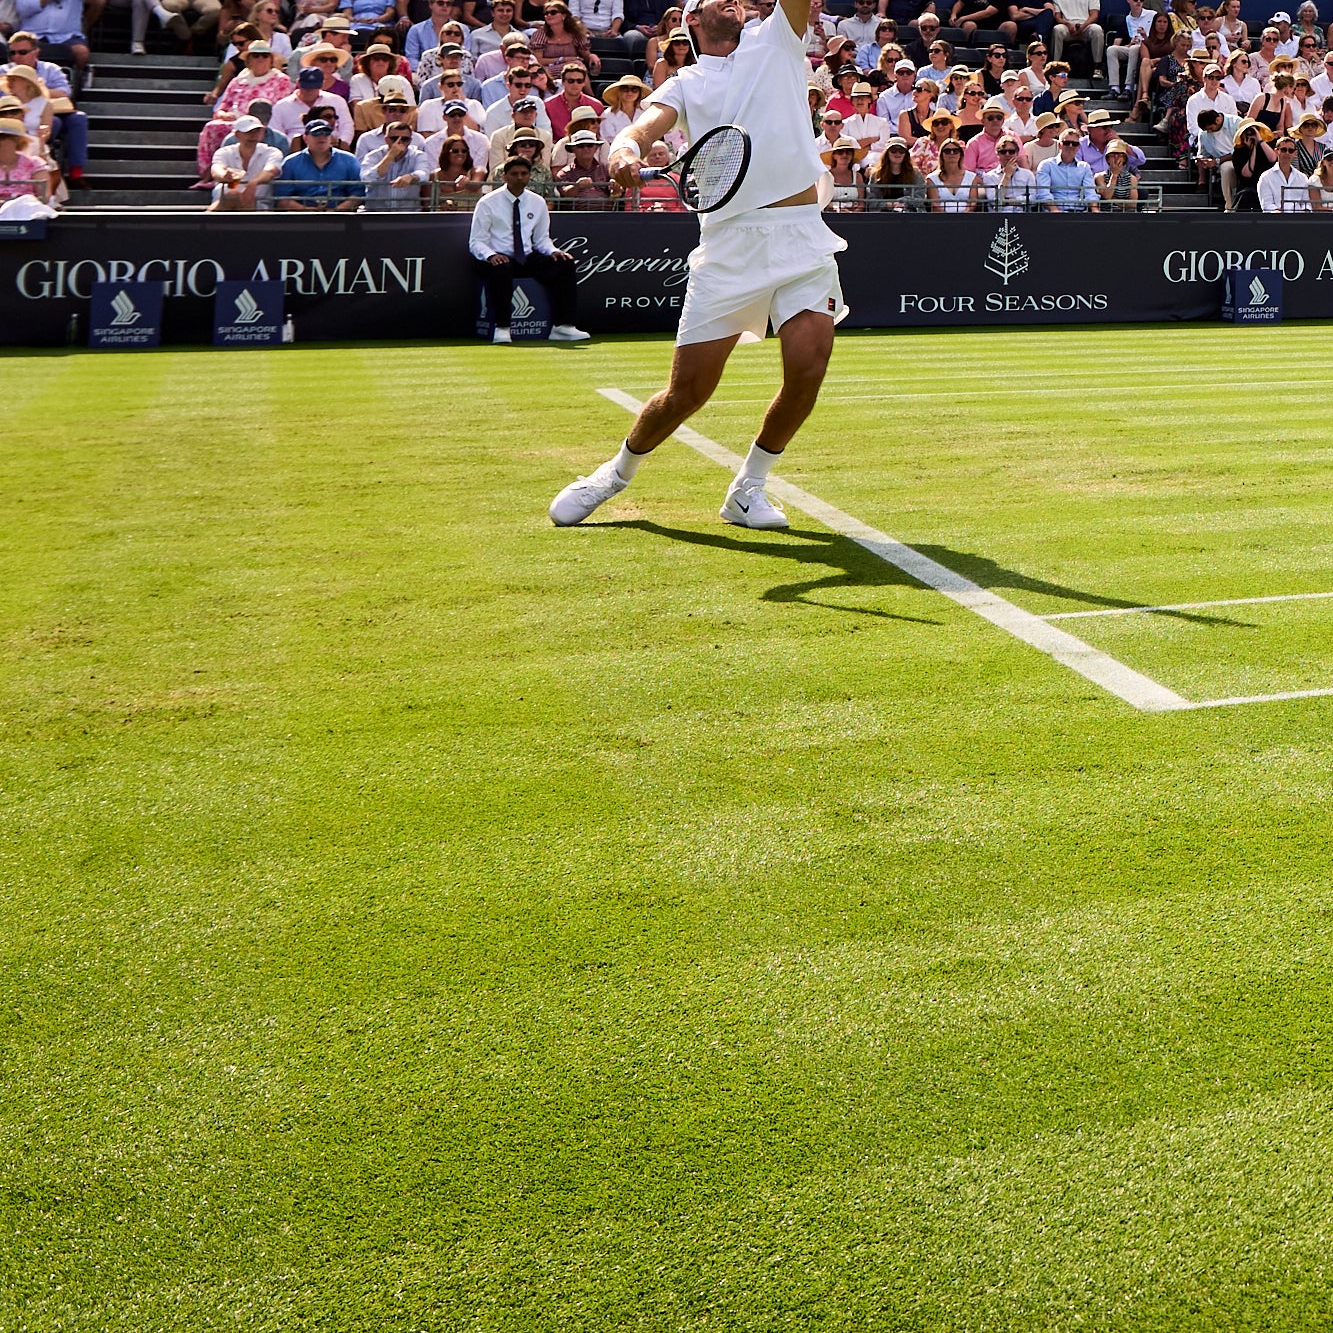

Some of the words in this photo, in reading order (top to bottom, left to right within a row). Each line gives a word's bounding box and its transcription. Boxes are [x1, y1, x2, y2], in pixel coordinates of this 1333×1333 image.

[1162, 250, 1305, 282] GIORGIO
[16, 259, 225, 299] GIORGIO
[251, 257, 426, 295] ARMANI
[605, 296, 681, 309] PROVE
[899, 294, 976, 313] FOUR
[985, 292, 1108, 312] SEASONS
[1238, 306, 1279, 314] SINGAPORE
[510, 320, 548, 328] GAPORE
[93, 327, 155, 336] SINGAPORE
[217, 326, 277, 334] SINGAPORE
[100, 335, 149, 343] AIRLINES
[223, 333, 271, 341] AIRLINES
